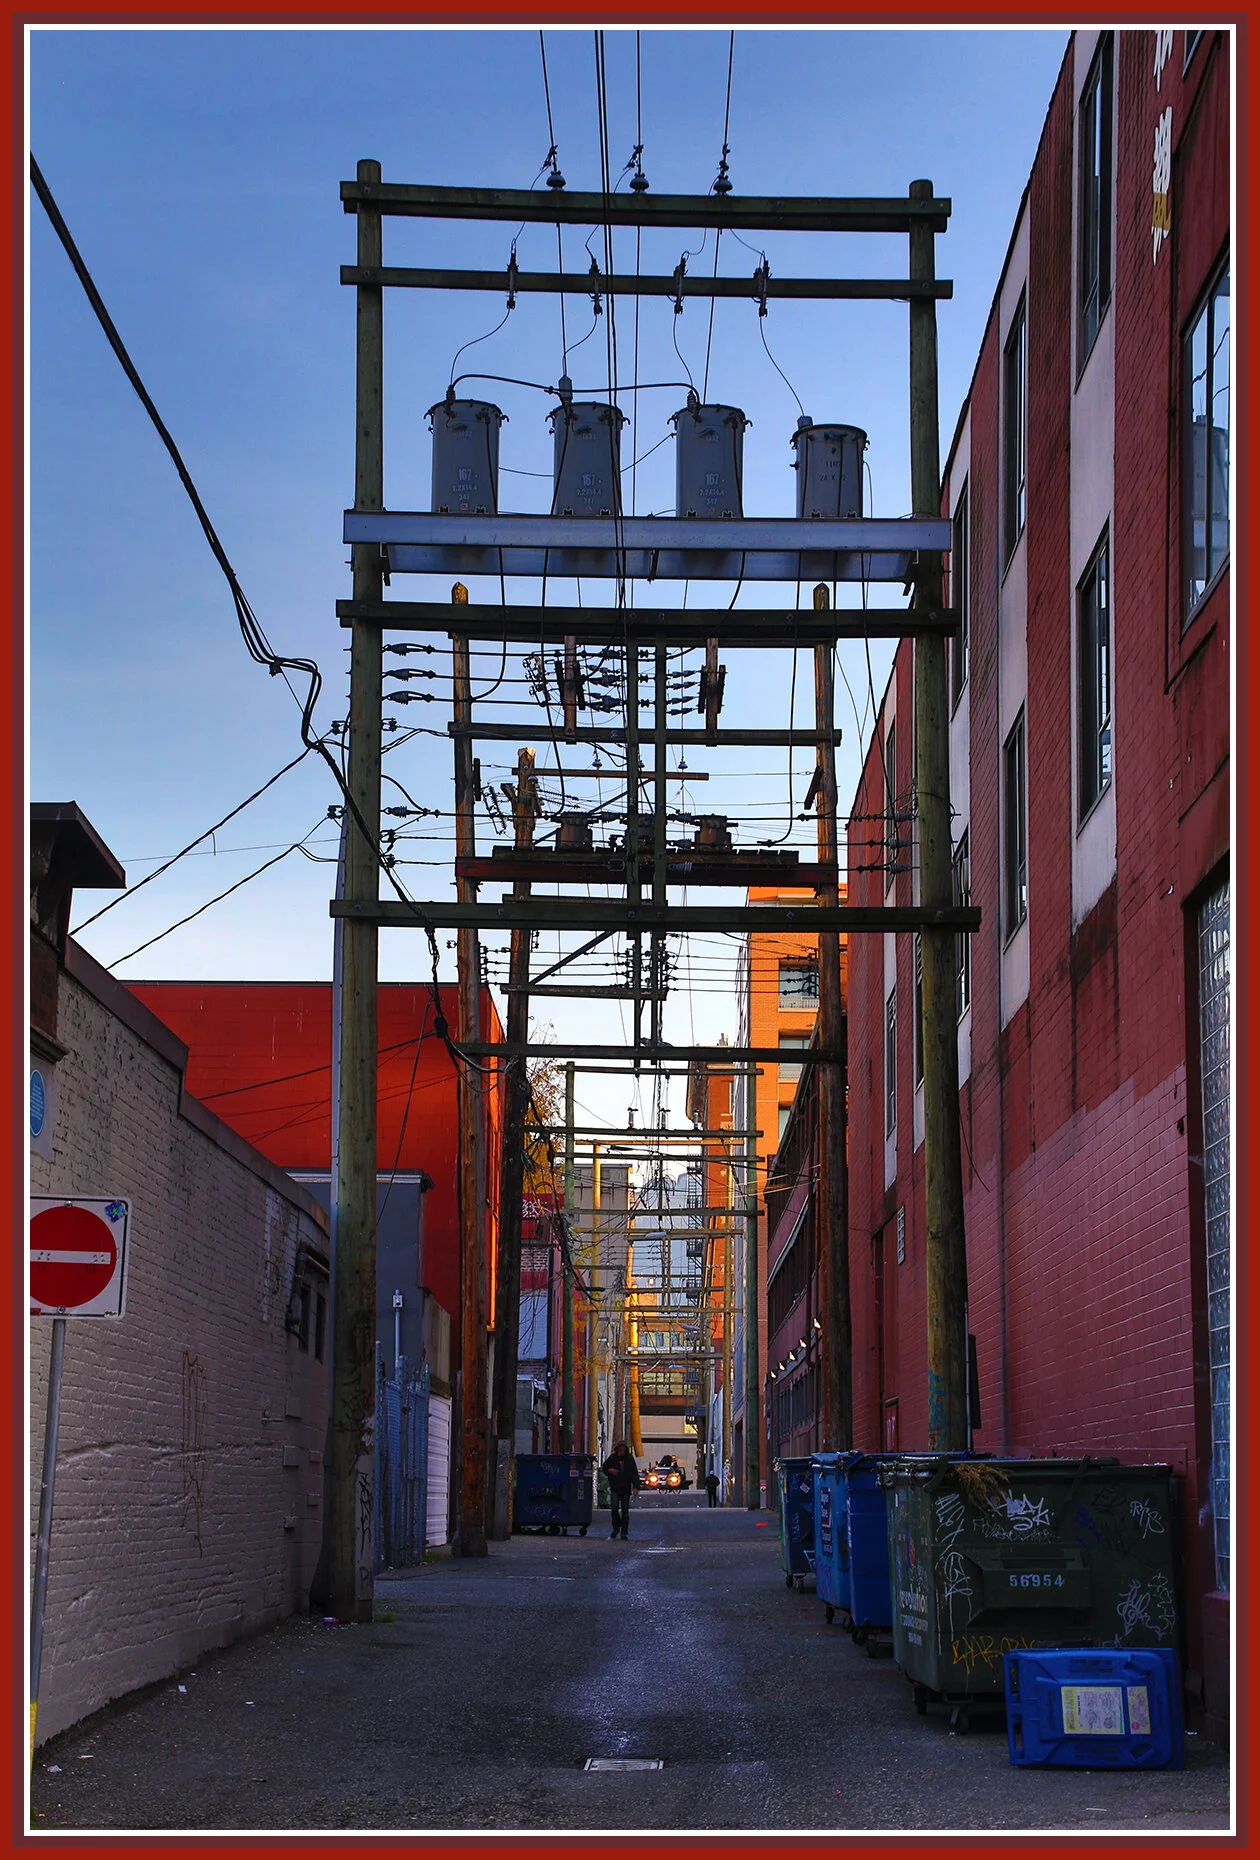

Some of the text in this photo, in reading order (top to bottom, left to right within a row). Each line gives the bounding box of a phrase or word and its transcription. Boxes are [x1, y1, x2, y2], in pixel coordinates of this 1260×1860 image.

[459, 468, 472, 481] 167
[582, 474, 596, 487] 167
[1009, 1574, 1064, 1588] 56954
